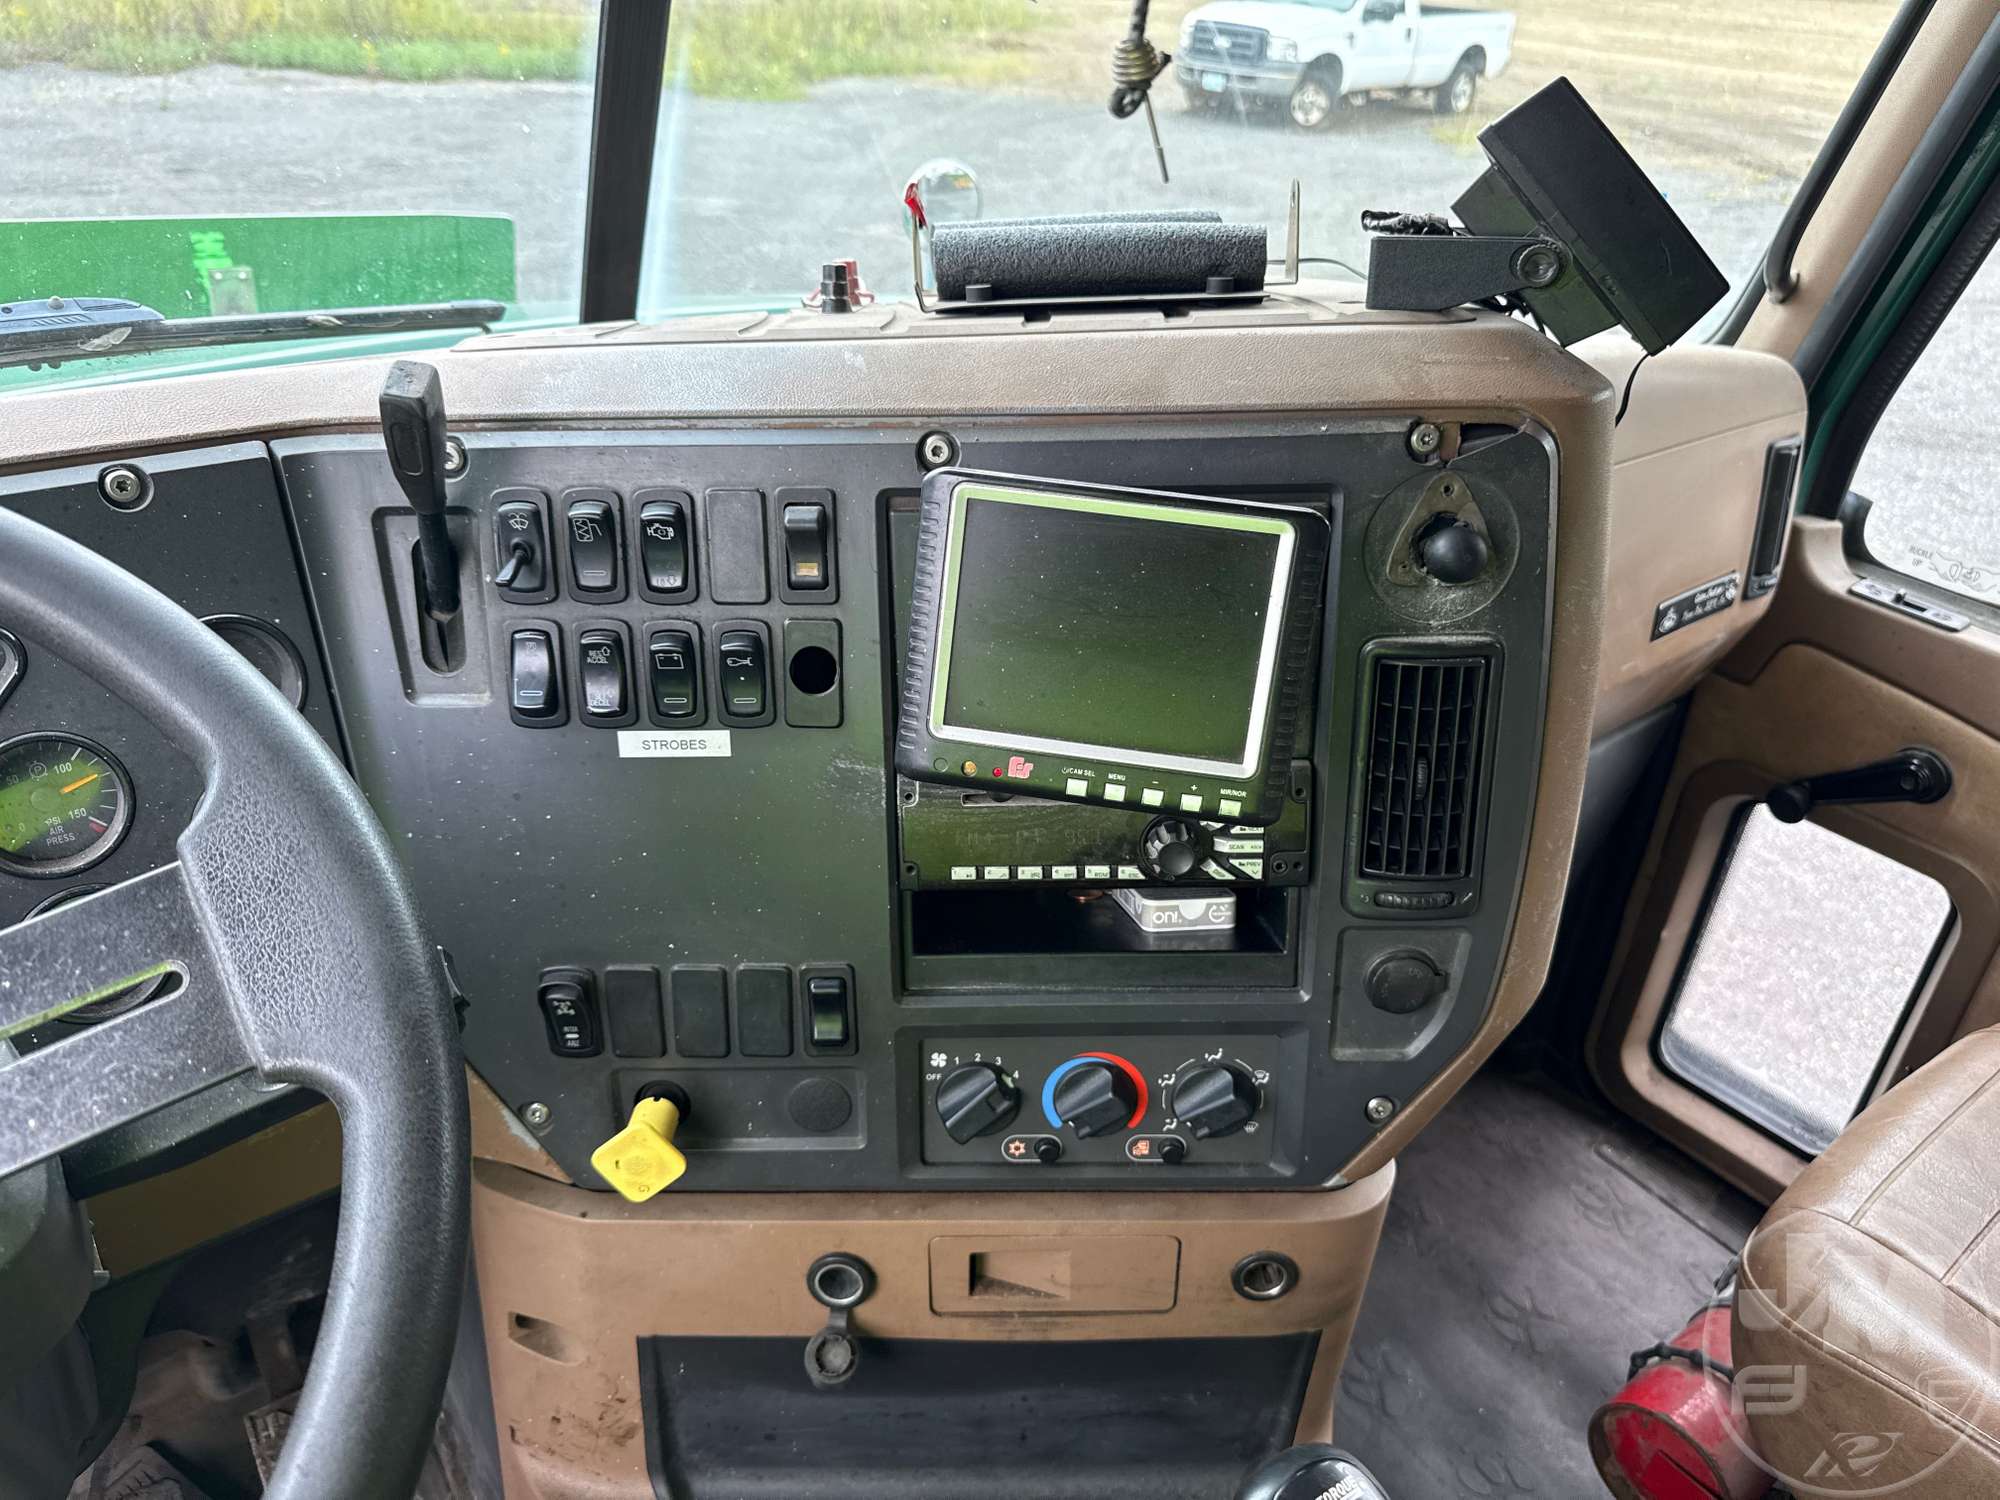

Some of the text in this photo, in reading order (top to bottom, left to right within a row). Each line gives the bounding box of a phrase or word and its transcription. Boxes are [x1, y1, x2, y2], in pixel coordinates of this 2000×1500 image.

[641, 739, 707, 750] STROBES
[53, 762, 72, 774] 100
[1069, 767, 1083, 775] CAM
[1107, 773, 1126, 781] MENU
[68, 808, 87, 819] 150
[49, 825, 65, 836] AIR
[46, 832, 76, 847] PRESS
[975, 1053, 981, 1062] 2
[995, 1056, 1001, 1065] 3
[1013, 1070, 1019, 1079] 4
